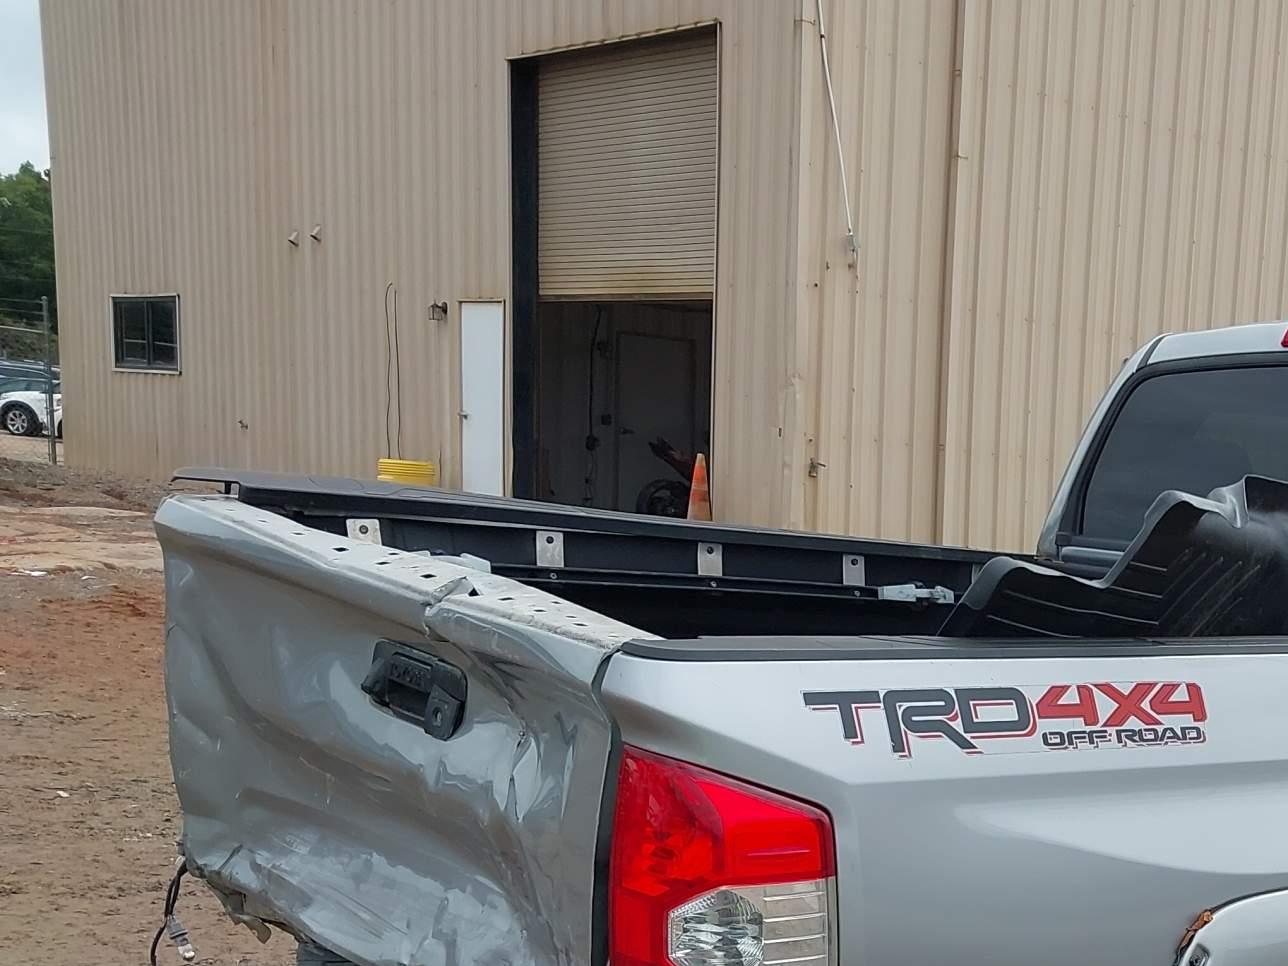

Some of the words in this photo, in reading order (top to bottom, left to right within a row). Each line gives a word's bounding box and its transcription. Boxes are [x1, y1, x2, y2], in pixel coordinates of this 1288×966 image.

[802, 686, 1036, 758] TRD
[1038, 682, 1208, 727] 4X4
[1042, 728, 1112, 749] OFF
[1116, 726, 1207, 745] ROAD
